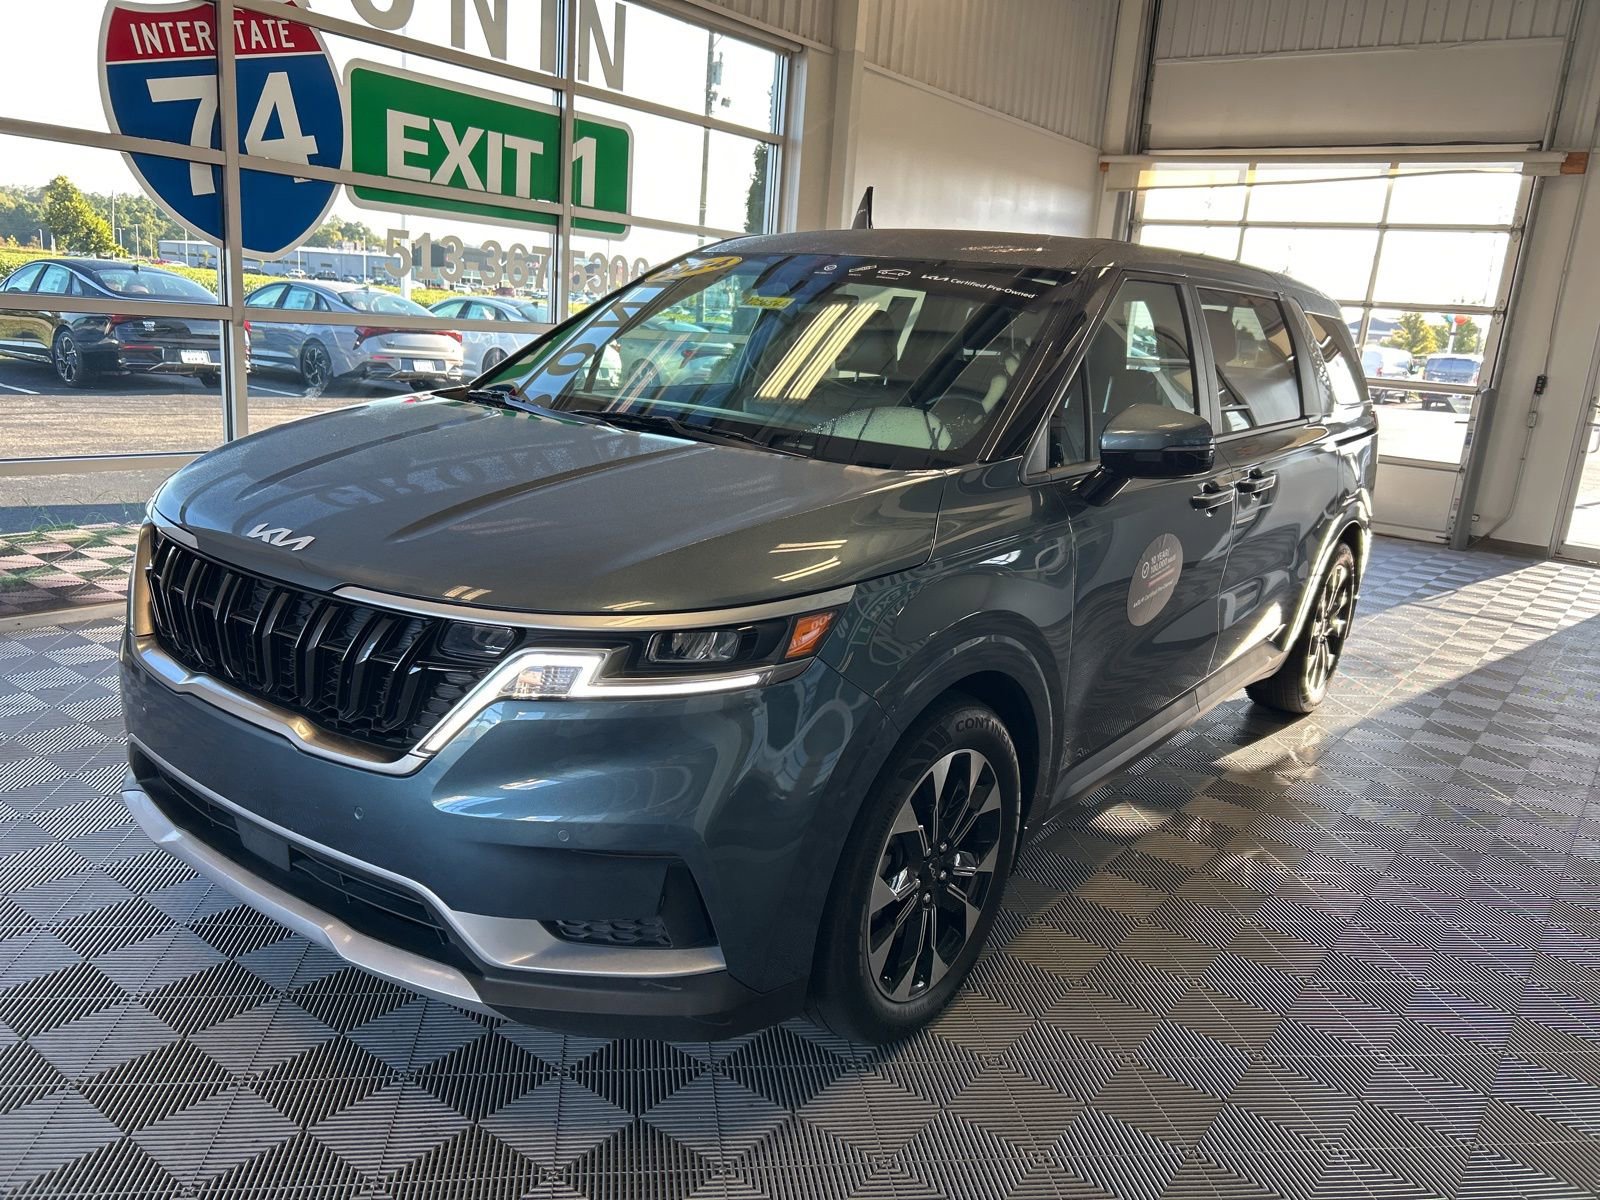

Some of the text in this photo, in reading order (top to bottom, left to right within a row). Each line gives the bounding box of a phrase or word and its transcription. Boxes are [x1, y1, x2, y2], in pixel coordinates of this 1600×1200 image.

[130, 19, 295, 55] INTERTATE
[146, 71, 319, 196] 74
[386, 108, 598, 208] EXIT 1
[950, 278, 987, 289] Certified
[986, 284, 1036, 299] Pre-Owned
[246, 522, 316, 551] KIA
